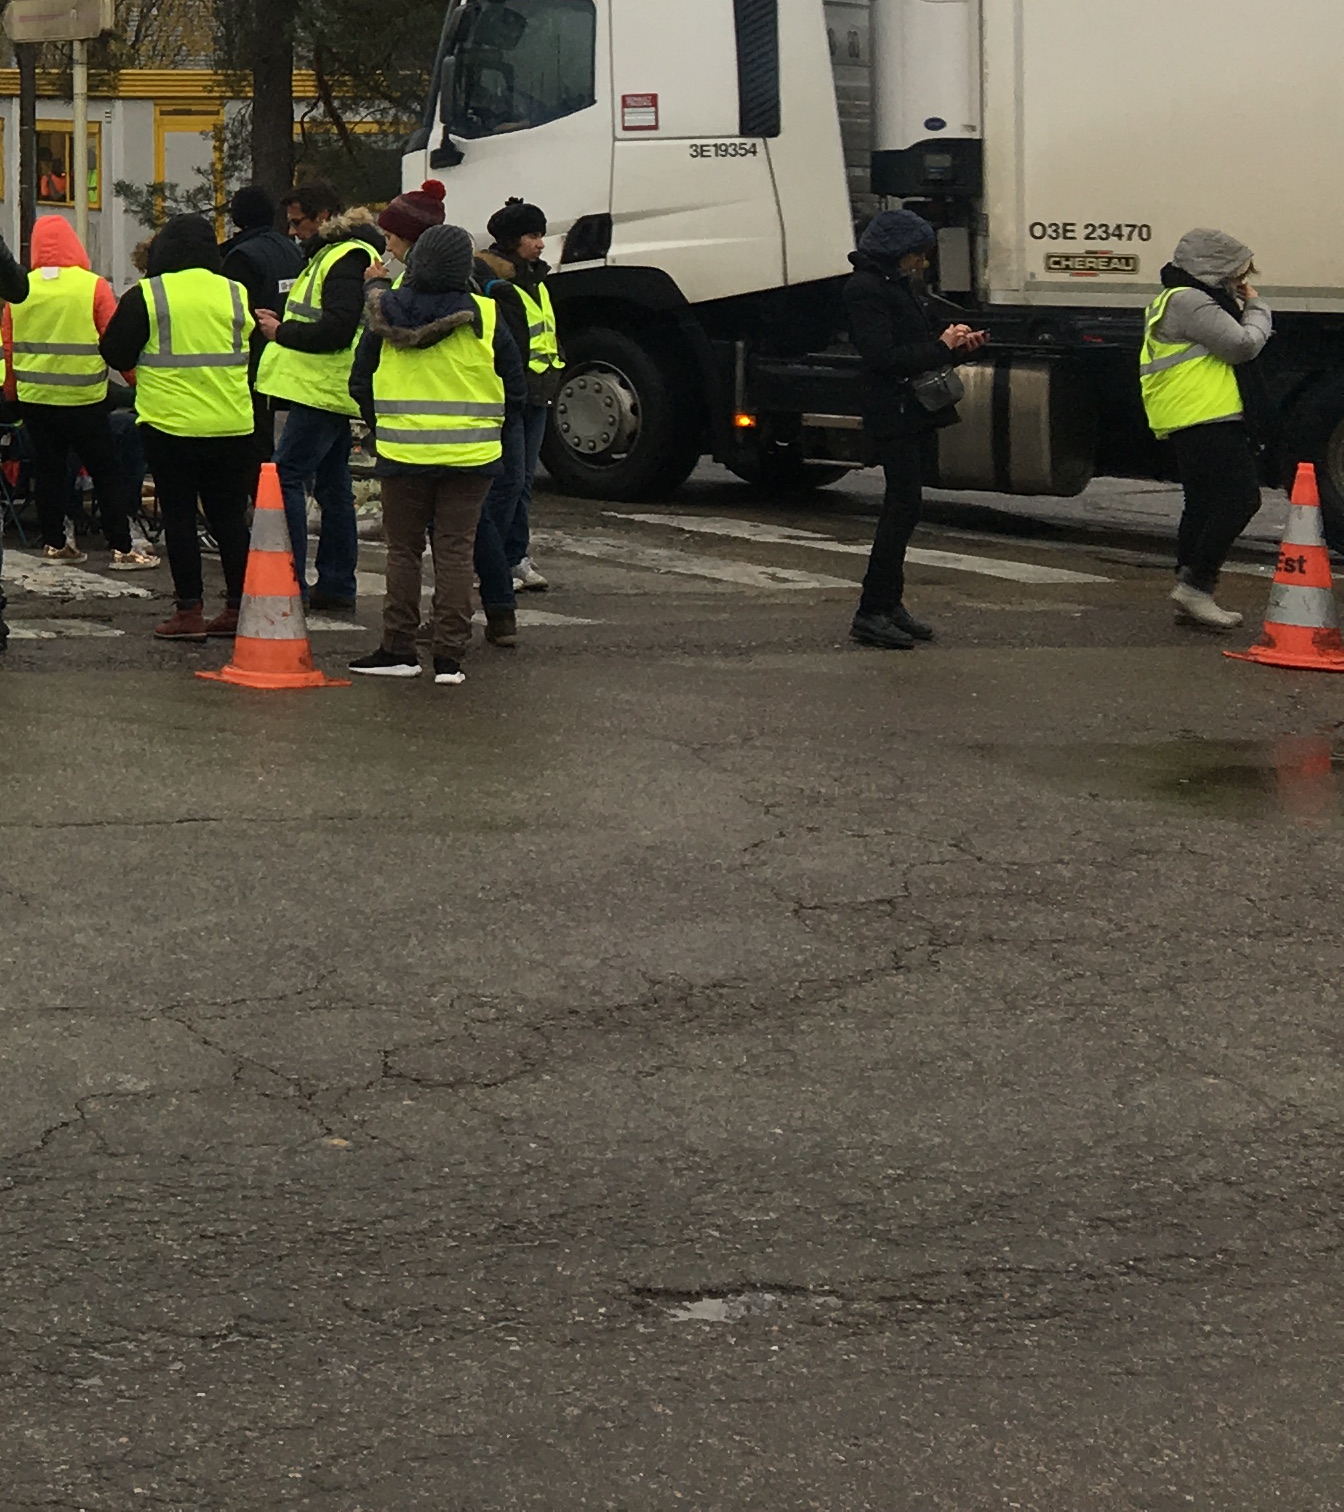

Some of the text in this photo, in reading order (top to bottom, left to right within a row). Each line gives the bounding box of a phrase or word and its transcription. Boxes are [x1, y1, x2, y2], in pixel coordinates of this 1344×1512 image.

[689, 143, 758, 158] 3E19354
[1083, 223, 1152, 241] 23470
[1049, 257, 1133, 270] CHEREAU
